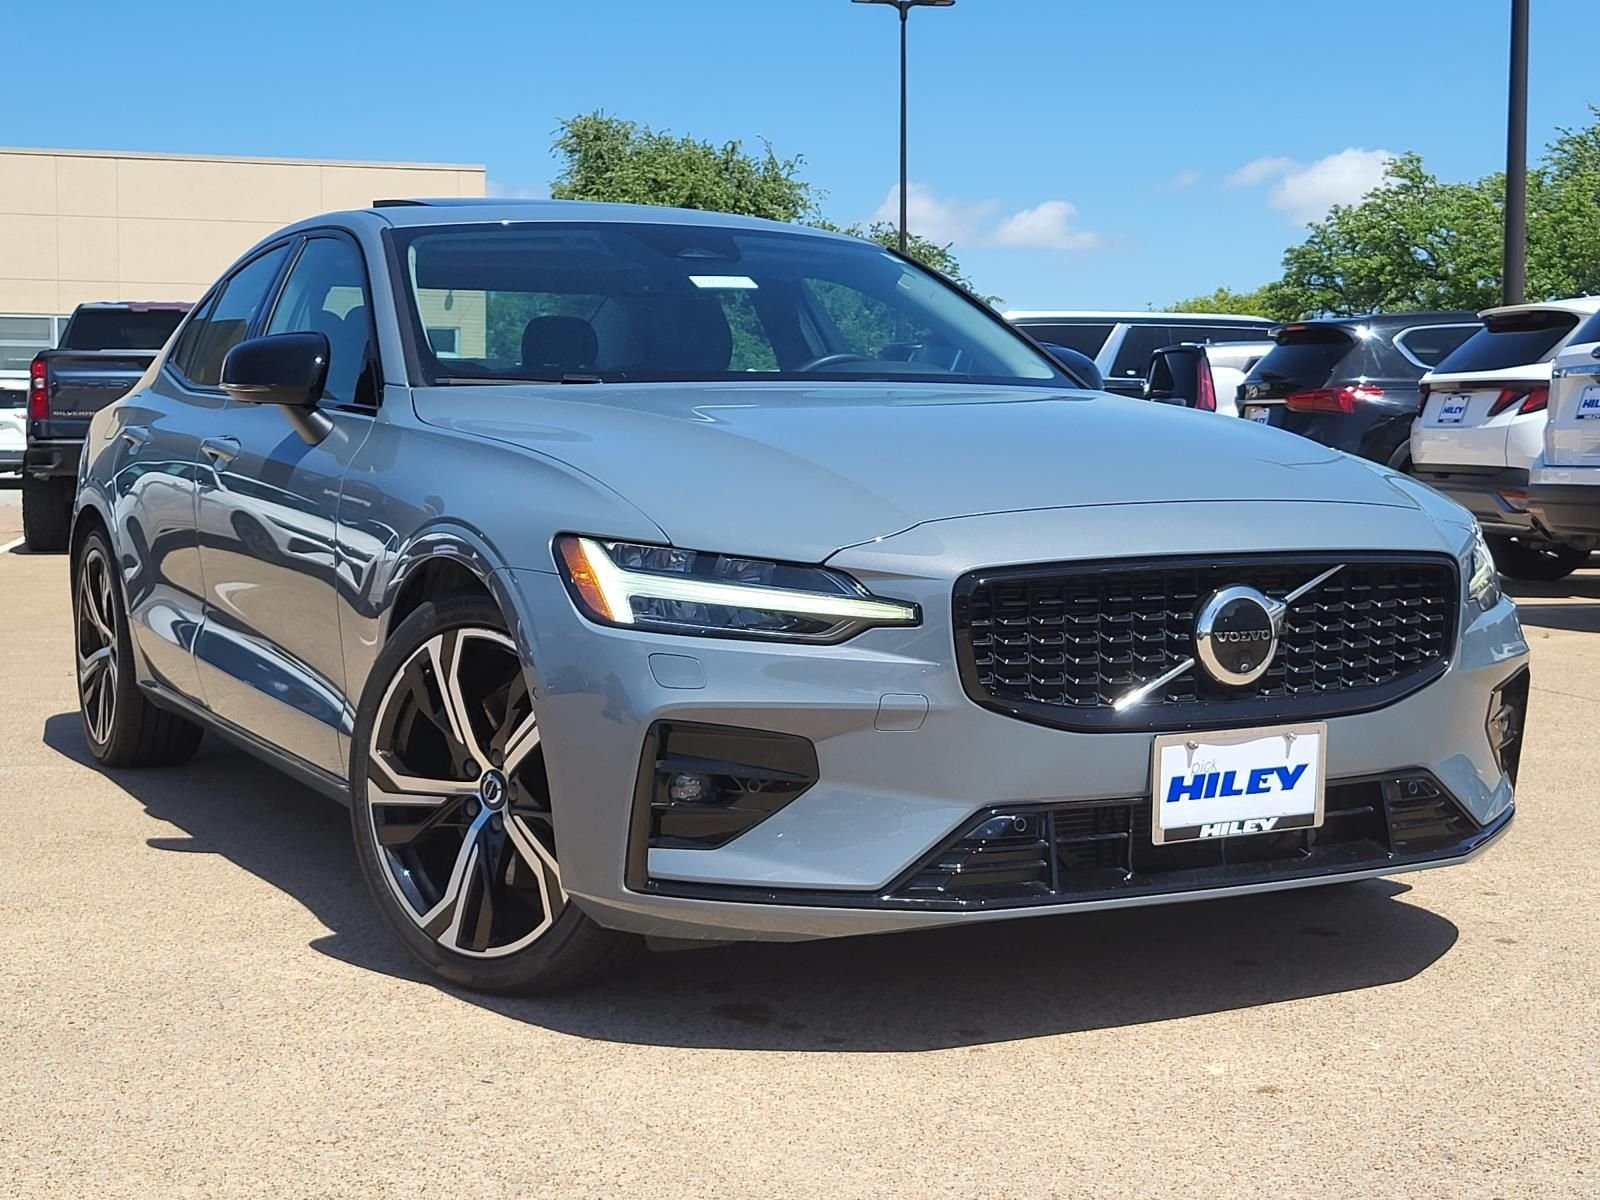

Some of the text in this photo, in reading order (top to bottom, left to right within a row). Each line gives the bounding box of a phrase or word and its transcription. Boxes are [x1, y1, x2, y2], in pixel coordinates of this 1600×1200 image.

[1582, 399, 1600, 408] HIL
[1214, 629, 1271, 642] VOLVO
[1166, 763, 1310, 803] HILEY
[1199, 816, 1279, 838] HILEY
